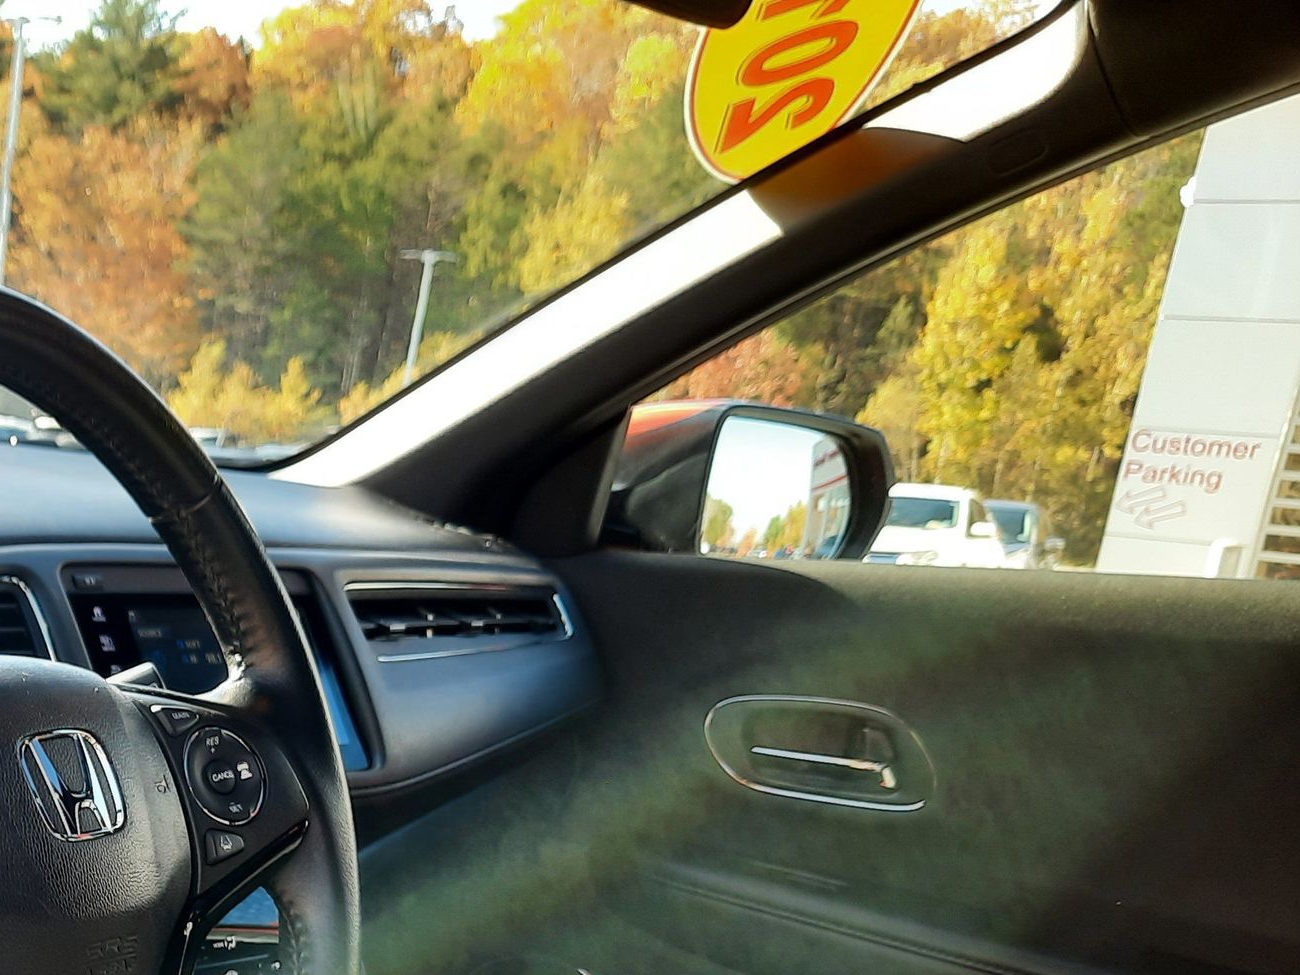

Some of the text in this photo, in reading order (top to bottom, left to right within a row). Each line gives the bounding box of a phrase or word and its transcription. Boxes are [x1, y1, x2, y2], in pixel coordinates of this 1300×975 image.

[1131, 428, 1262, 461] Customer
[1124, 459, 1223, 494] Parking
[171, 711, 191, 720] MAIN
[205, 736, 220, 747] RES
